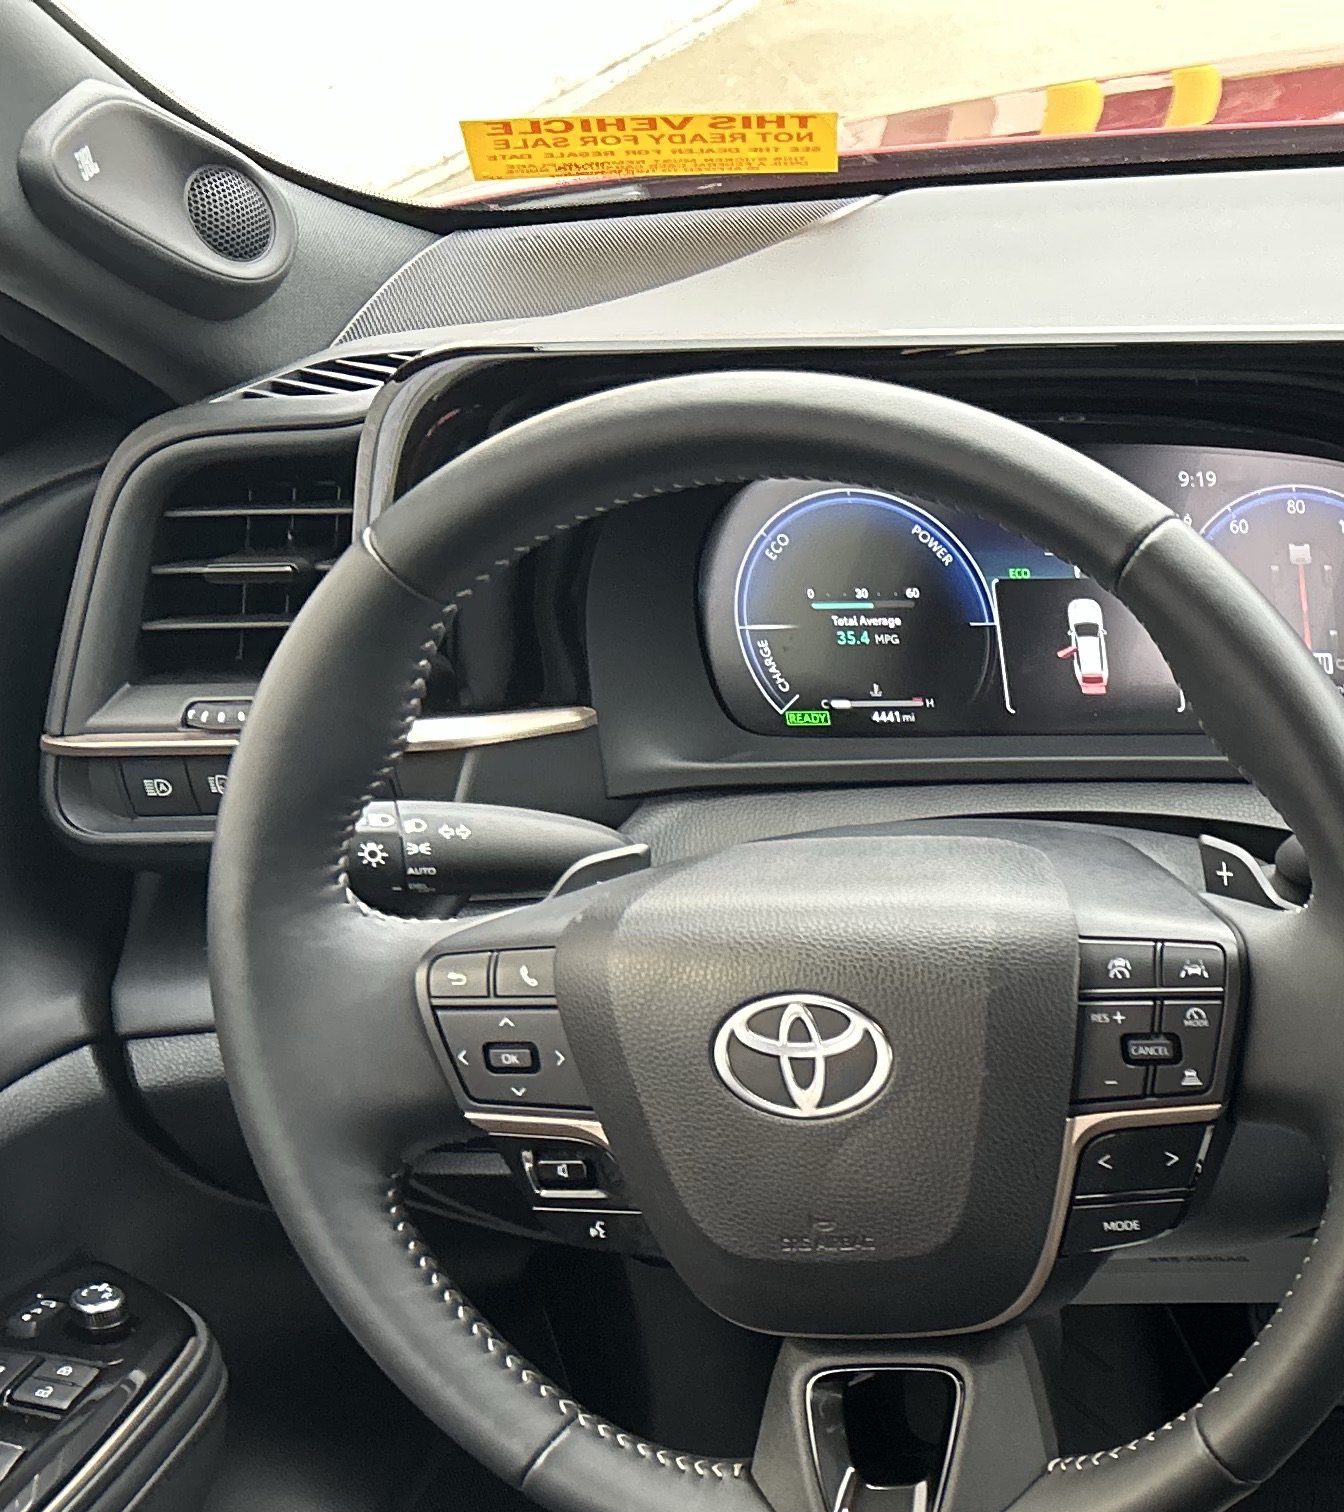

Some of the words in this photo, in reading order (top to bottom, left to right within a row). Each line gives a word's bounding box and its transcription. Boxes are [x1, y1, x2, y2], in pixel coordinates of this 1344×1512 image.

[1178, 470, 1217, 488] 9:19
[1286, 499, 1306, 515] 80
[1229, 519, 1249, 535] 60
[765, 533, 790, 561] ECO
[911, 524, 954, 567] POWER
[1008, 568, 1031, 580] ECO
[806, 588, 815, 599] 0
[855, 588, 869, 599] 30
[905, 588, 920, 599] 60
[831, 615, 857, 627] Total
[859, 615, 902, 629] Average
[836, 631, 871, 645] 35.4
[875, 633, 900, 645] MPG
[756, 638, 791, 694] CHARGE
[821, 699, 831, 709] C
[925, 698, 935, 708] H
[788, 713, 827, 724] READY
[871, 710, 901, 723] 4441
[902, 711, 915, 722] mi
[407, 866, 437, 876] AUTO
[1090, 1013, 1110, 1024] RES
[1183, 1018, 1210, 1027] MODE
[1130, 1045, 1170, 1056] CANCEL
[501, 1053, 519, 1065] OK
[1102, 1220, 1141, 1232] MODE
